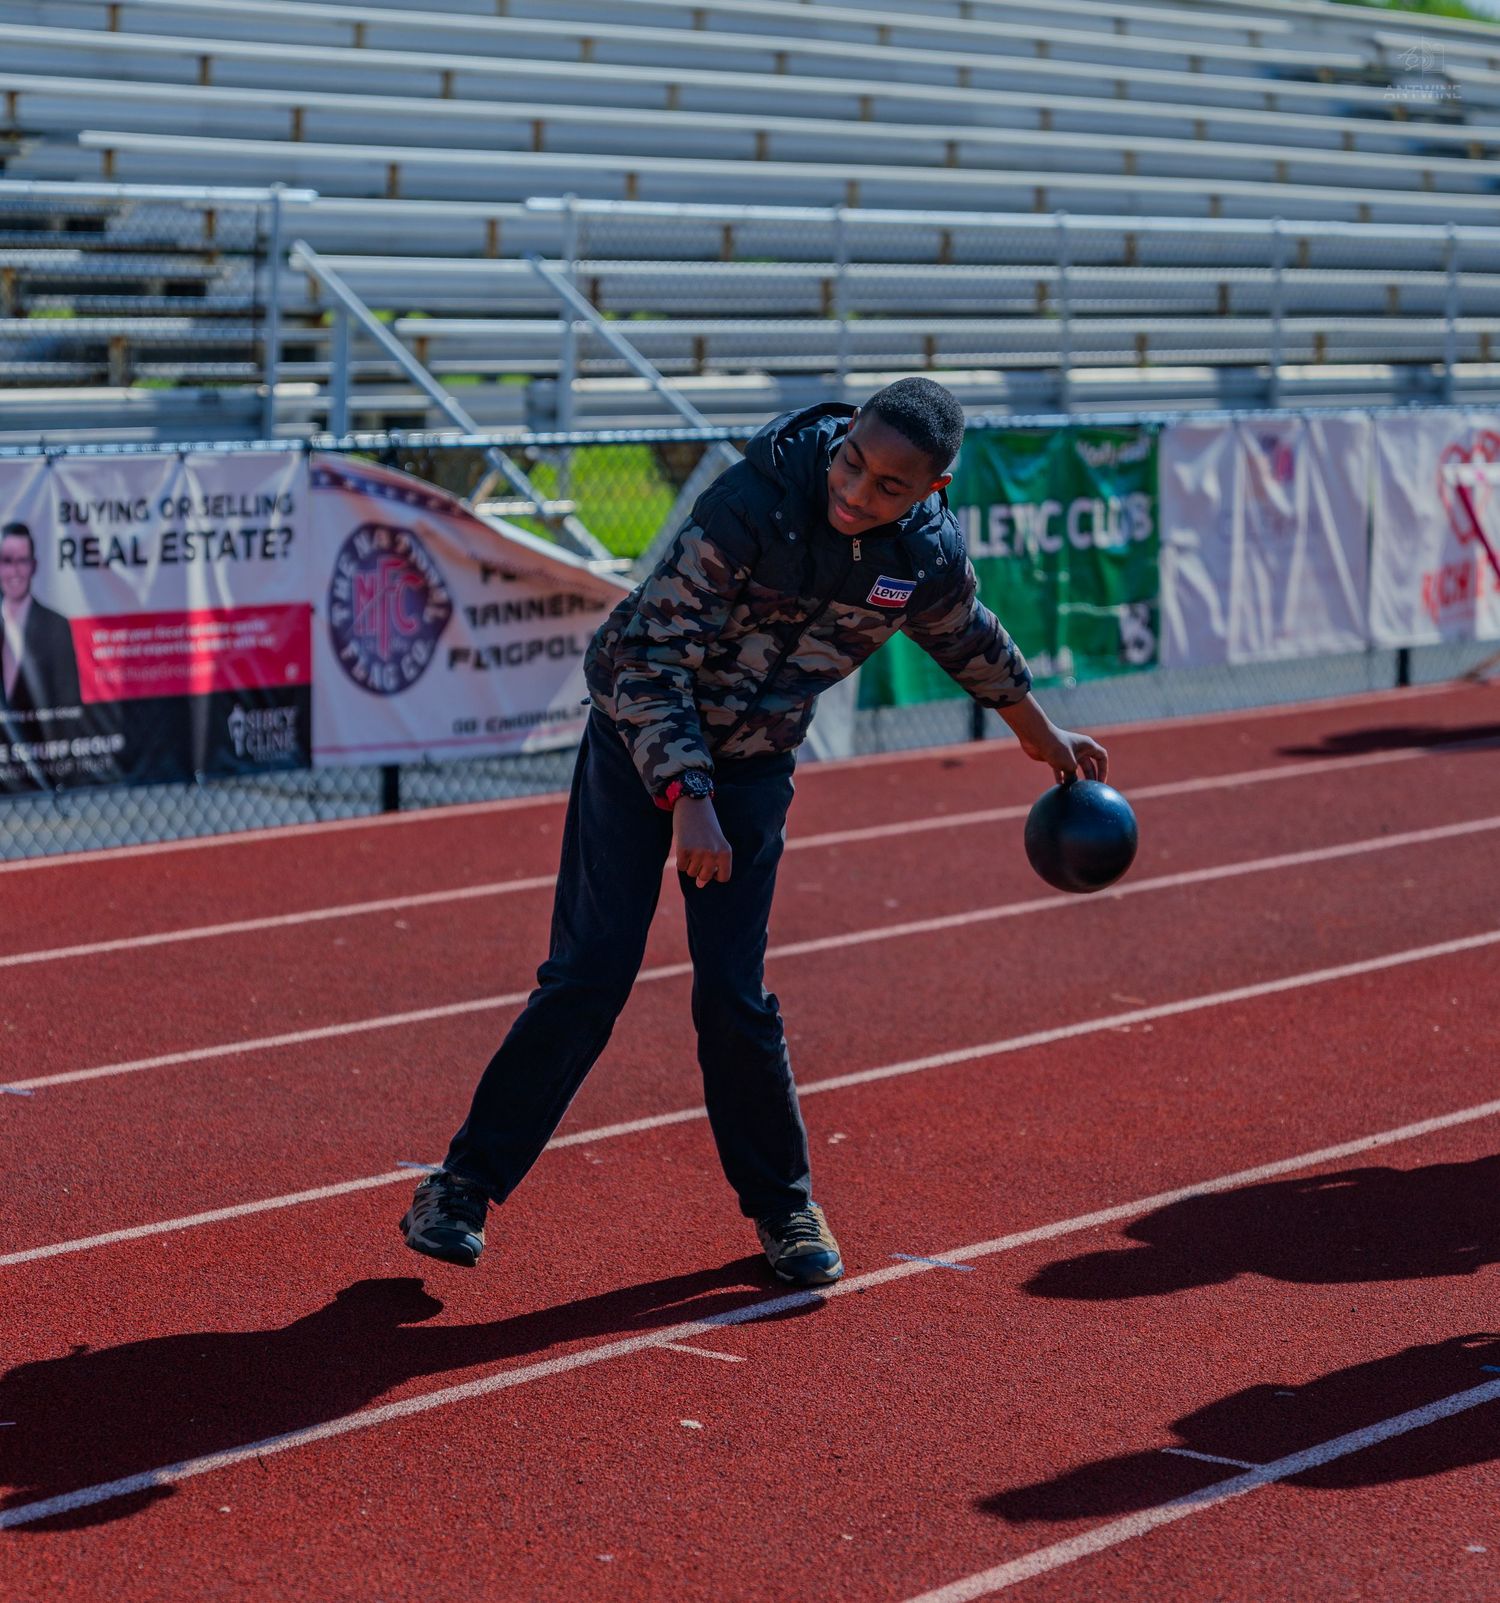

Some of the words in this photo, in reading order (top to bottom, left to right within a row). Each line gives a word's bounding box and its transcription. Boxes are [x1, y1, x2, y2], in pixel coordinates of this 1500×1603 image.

[58, 499, 149, 524] BUYING
[159, 497, 192, 519] OR
[201, 493, 294, 518] SELLING
[58, 536, 148, 569] REAL
[161, 527, 293, 563] ESTATE?
[71, 734, 125, 757] GROUP
